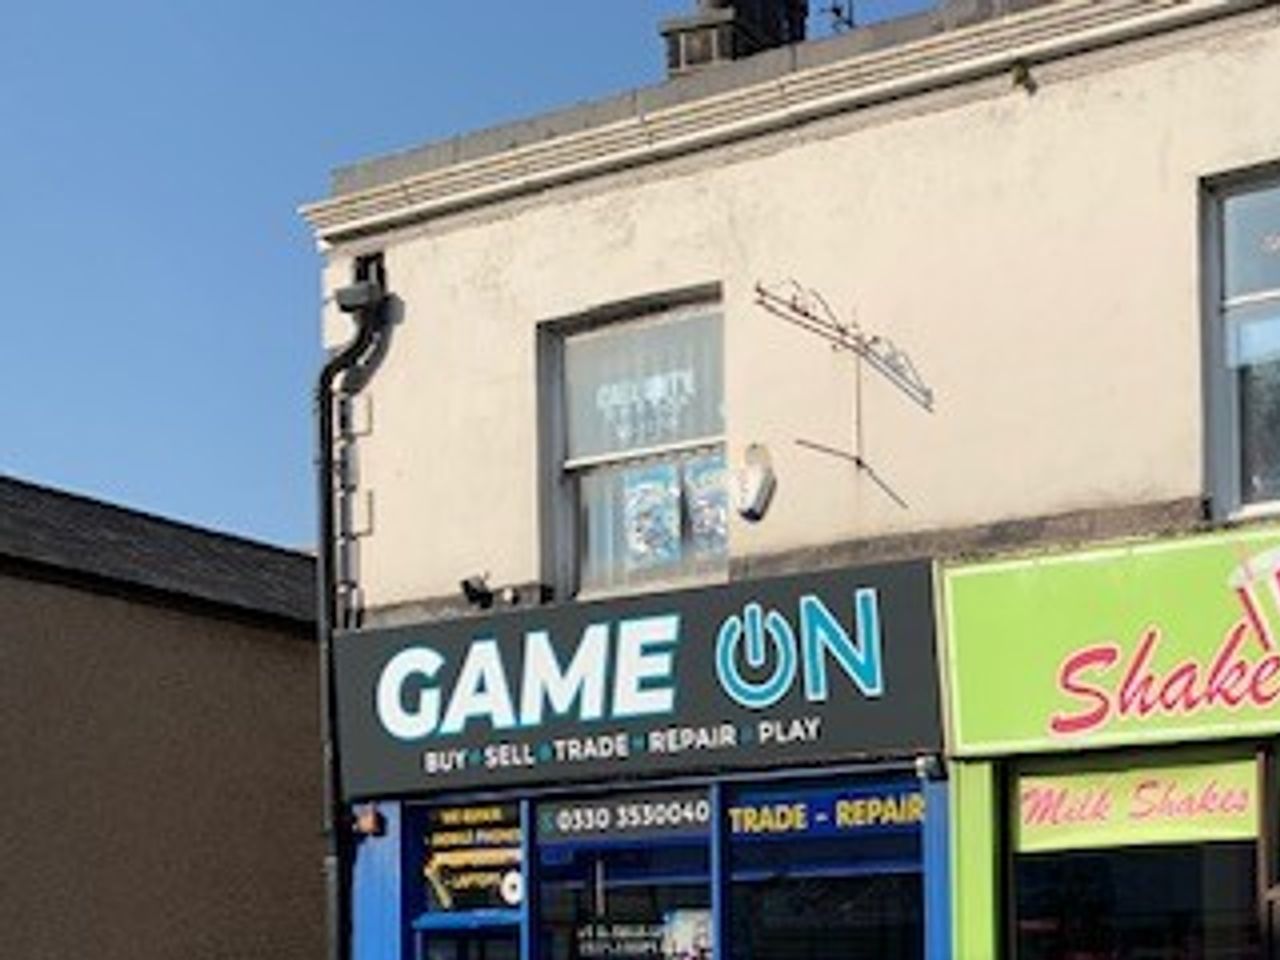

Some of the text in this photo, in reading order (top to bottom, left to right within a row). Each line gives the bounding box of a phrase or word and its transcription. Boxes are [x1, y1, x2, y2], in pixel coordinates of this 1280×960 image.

[375, 587, 885, 742] GAME ON
[424, 717, 821, 775] BUY SELL TRADE REPAIR PLAY
[555, 799, 712, 832] 0330 3530040
[727, 804, 809, 834] TRADE
[835, 793, 926, 829] REPAIR
[1022, 776, 1251, 827] Milk Shakes
